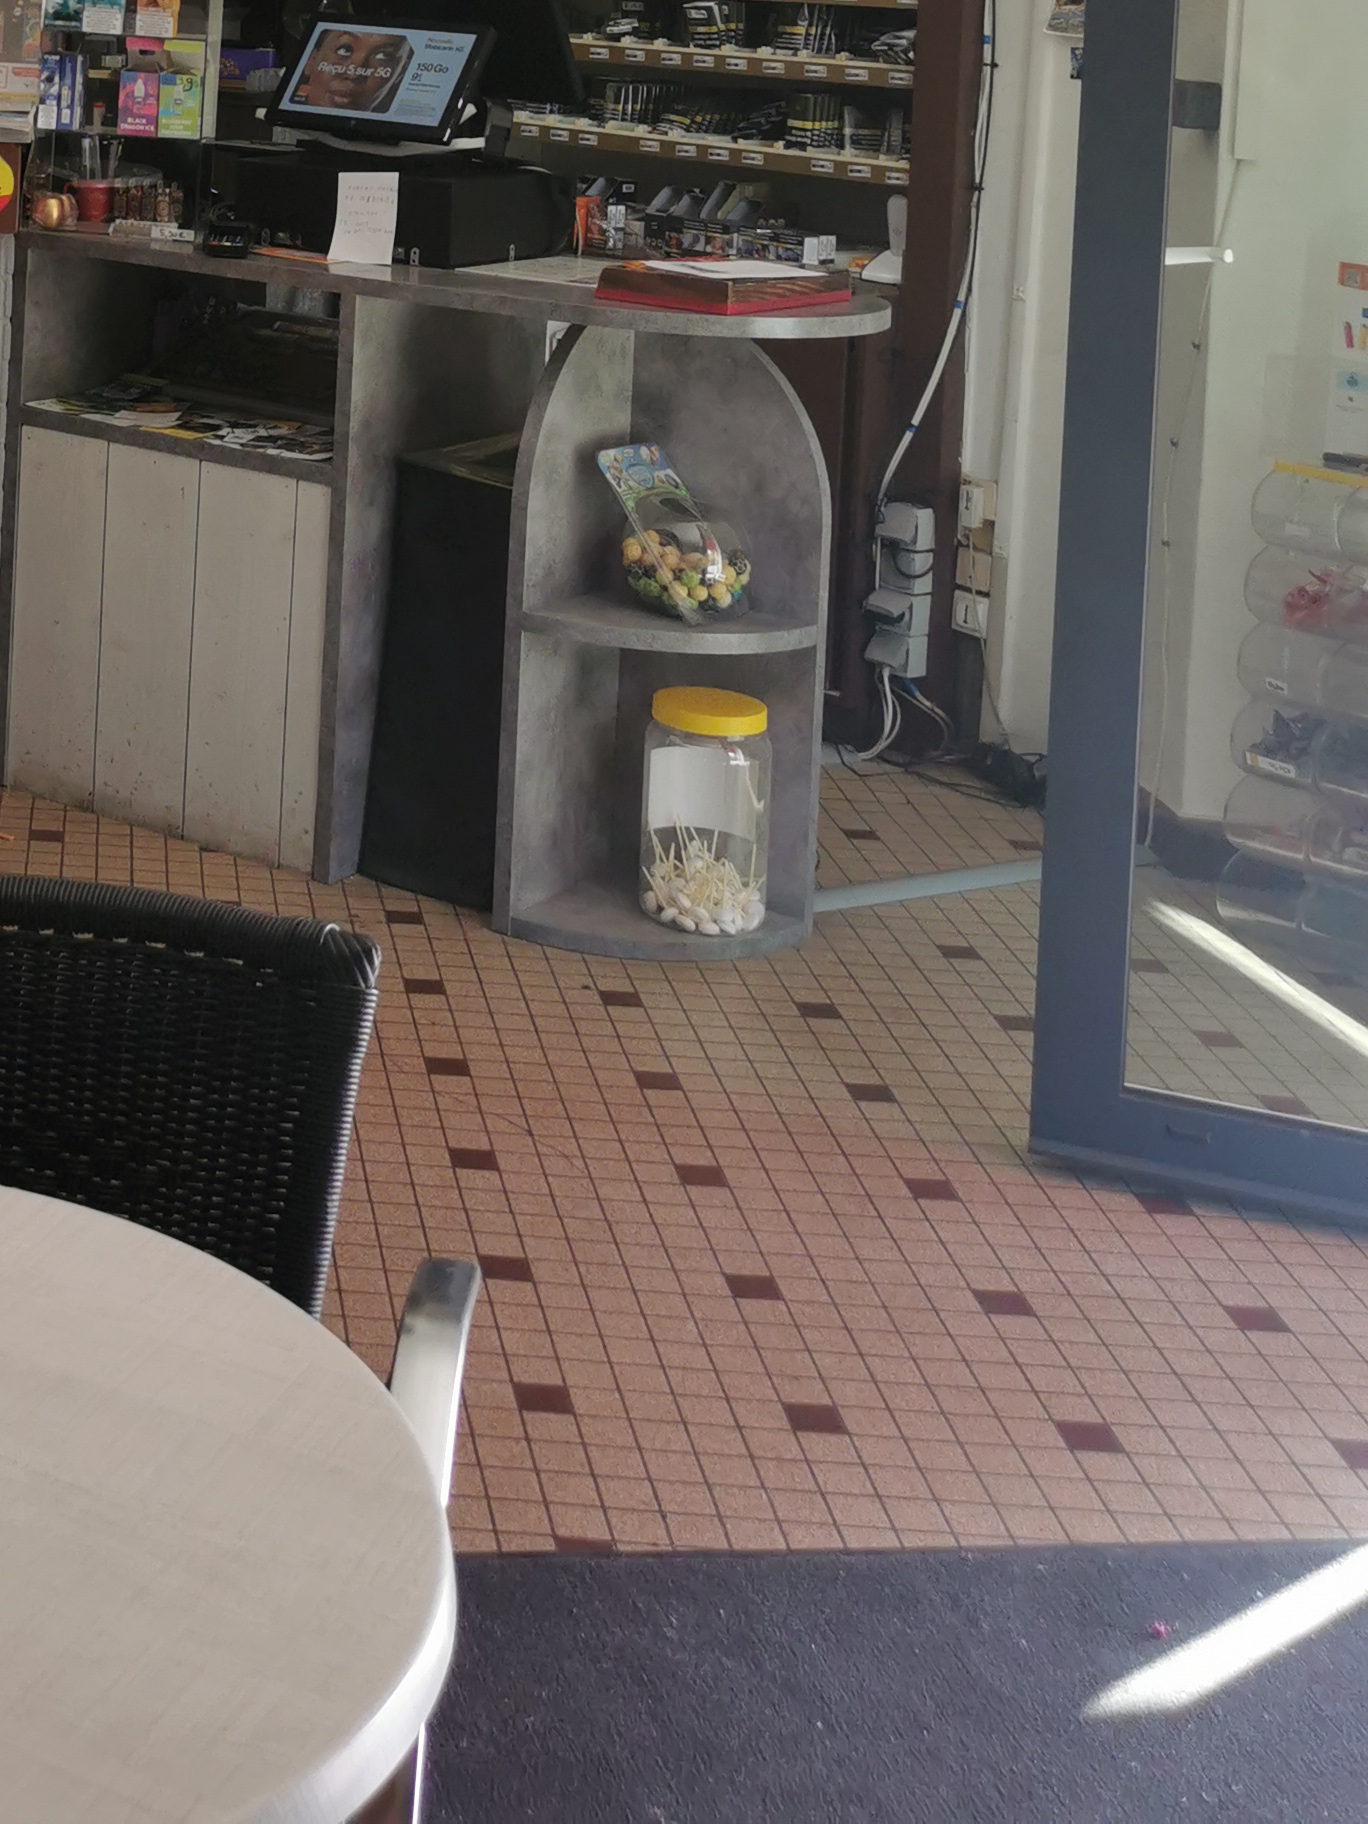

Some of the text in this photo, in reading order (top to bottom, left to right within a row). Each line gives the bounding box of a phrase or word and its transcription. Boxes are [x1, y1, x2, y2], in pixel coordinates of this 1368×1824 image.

[356, 66, 374, 76] sur
[374, 66, 392, 78] 5G
[416, 62, 449, 74] 150 Go
